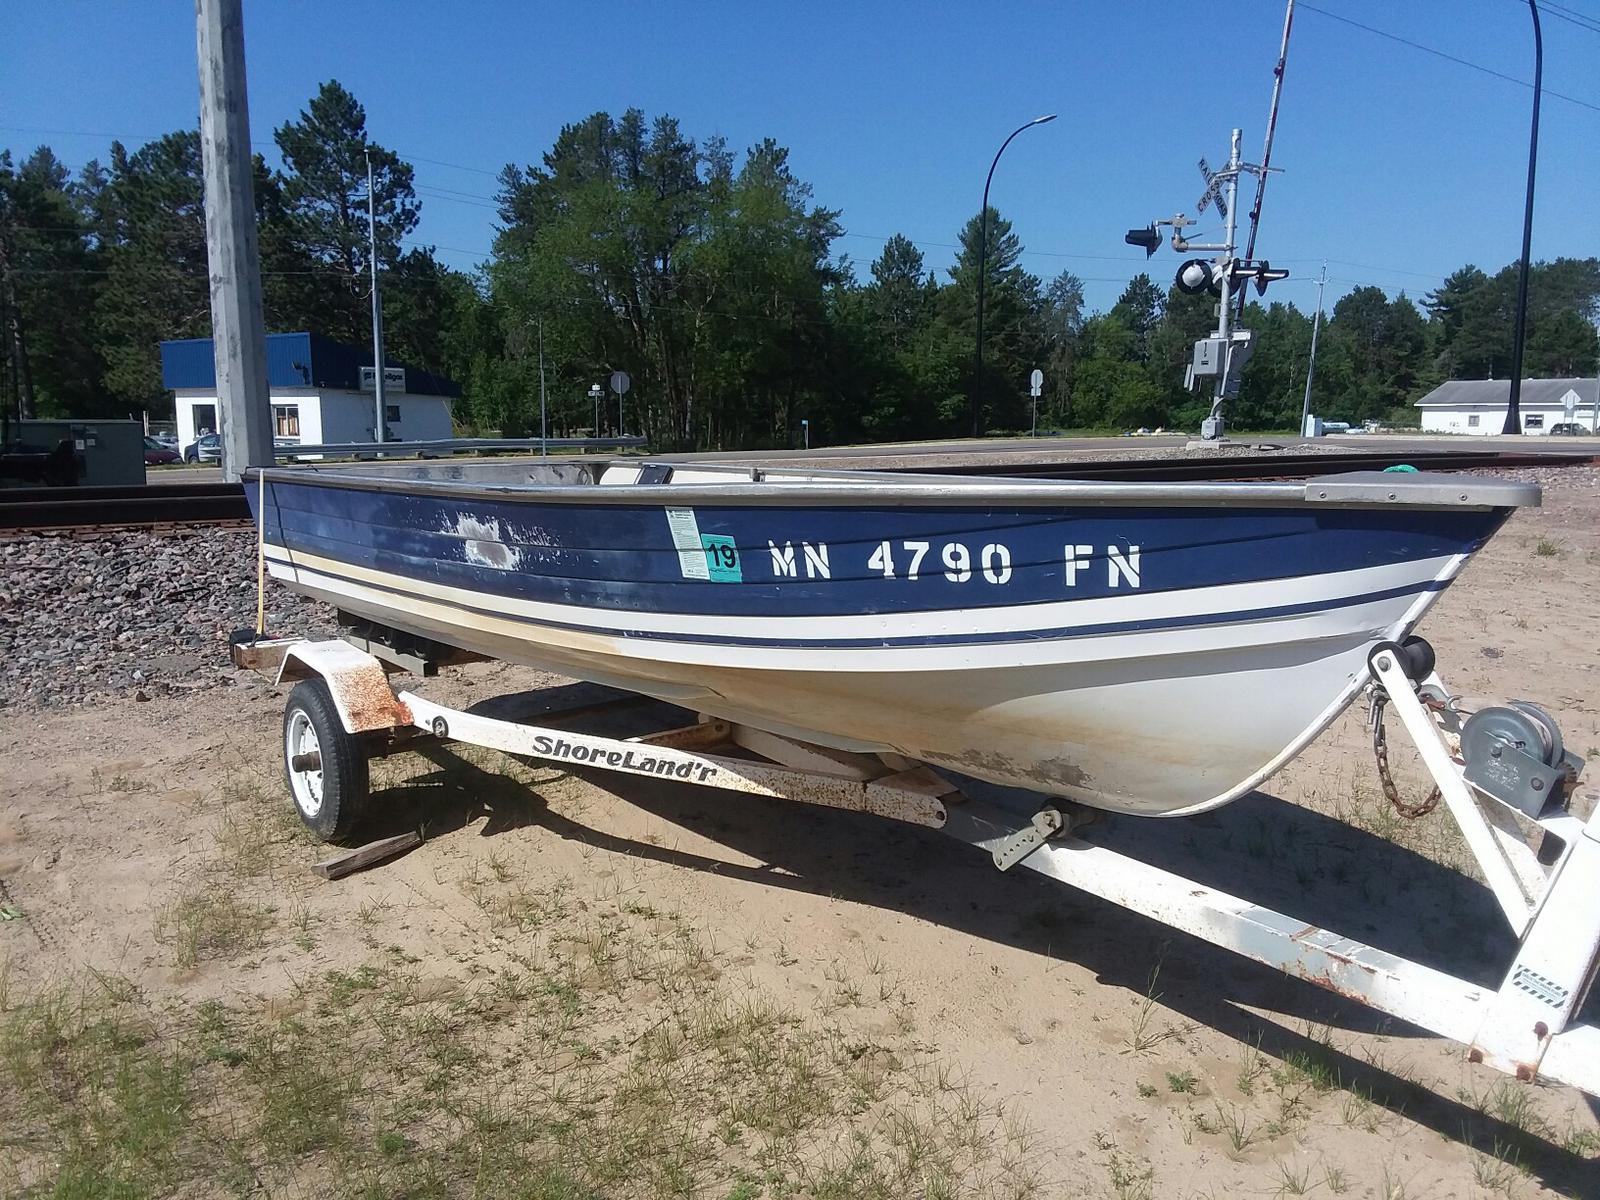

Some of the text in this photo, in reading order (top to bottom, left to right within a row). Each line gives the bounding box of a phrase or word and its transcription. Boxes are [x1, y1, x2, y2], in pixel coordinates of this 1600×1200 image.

[708, 543, 736, 569] 19
[768, 540, 1141, 588] MN 4790 FN
[532, 735, 718, 782] ShoreLand'r
